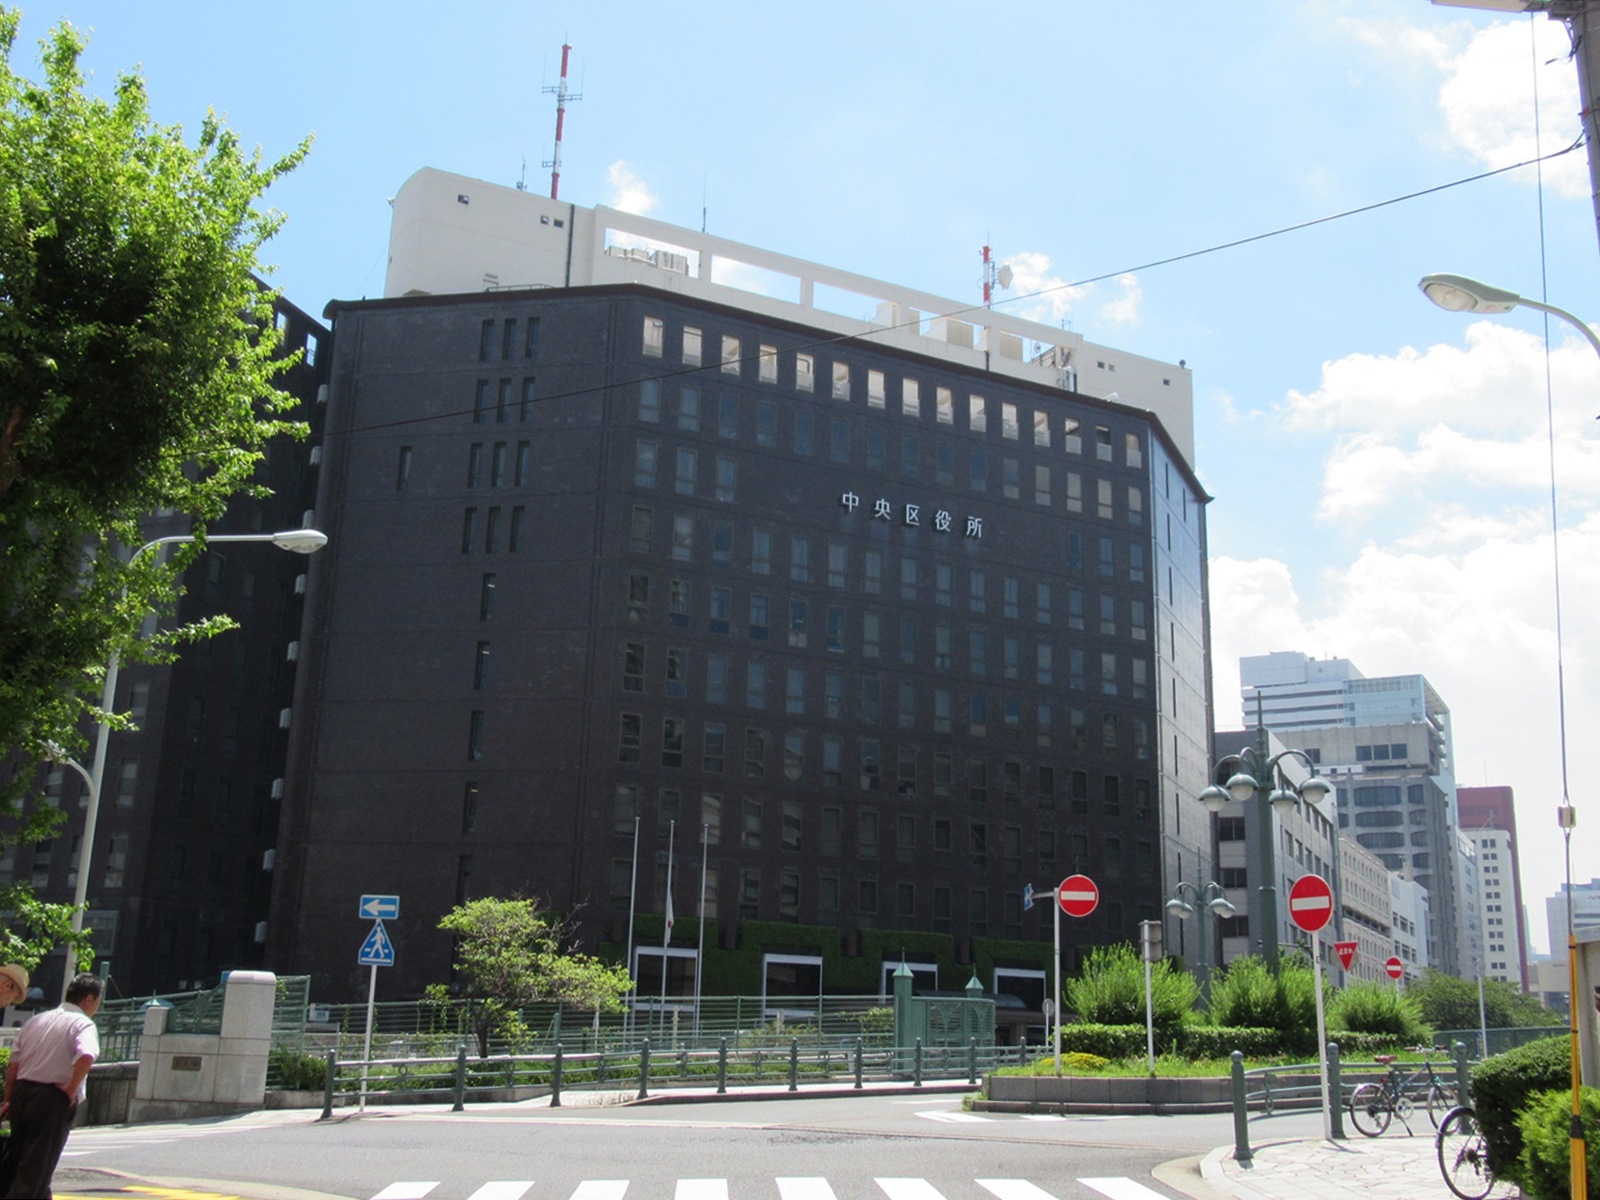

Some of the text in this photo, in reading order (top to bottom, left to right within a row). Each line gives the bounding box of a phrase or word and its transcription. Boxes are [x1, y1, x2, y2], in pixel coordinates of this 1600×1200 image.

[842, 491, 983, 538] 中央区役所
